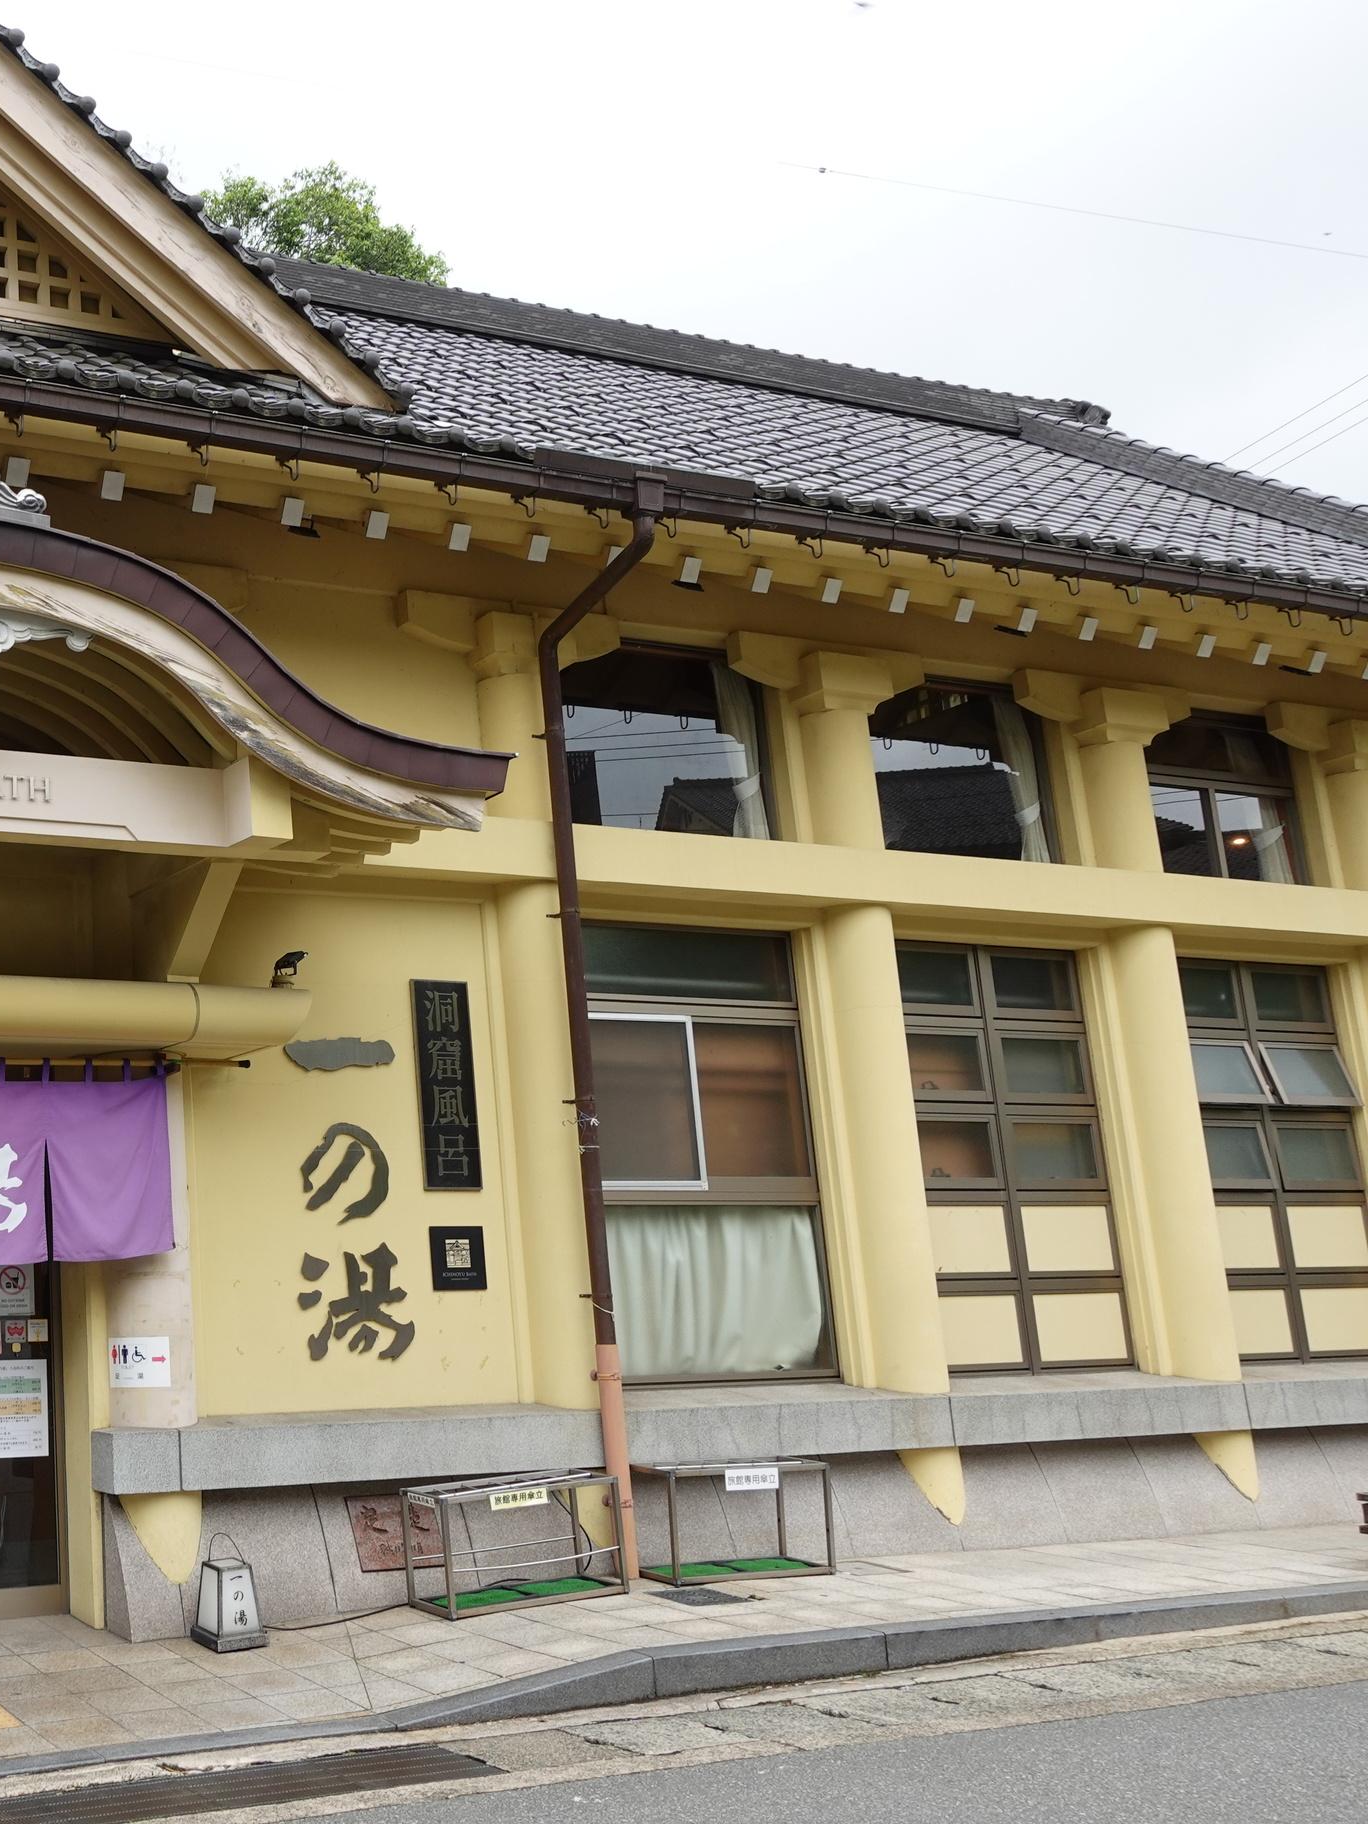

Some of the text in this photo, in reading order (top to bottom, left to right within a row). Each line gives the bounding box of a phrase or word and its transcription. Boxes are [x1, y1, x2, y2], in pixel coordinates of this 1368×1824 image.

[423, 990, 470, 1178] 洞窟風呂
[283, 1036, 416, 1362] 一の湯
[229, 1575, 248, 1626] 一の湯
